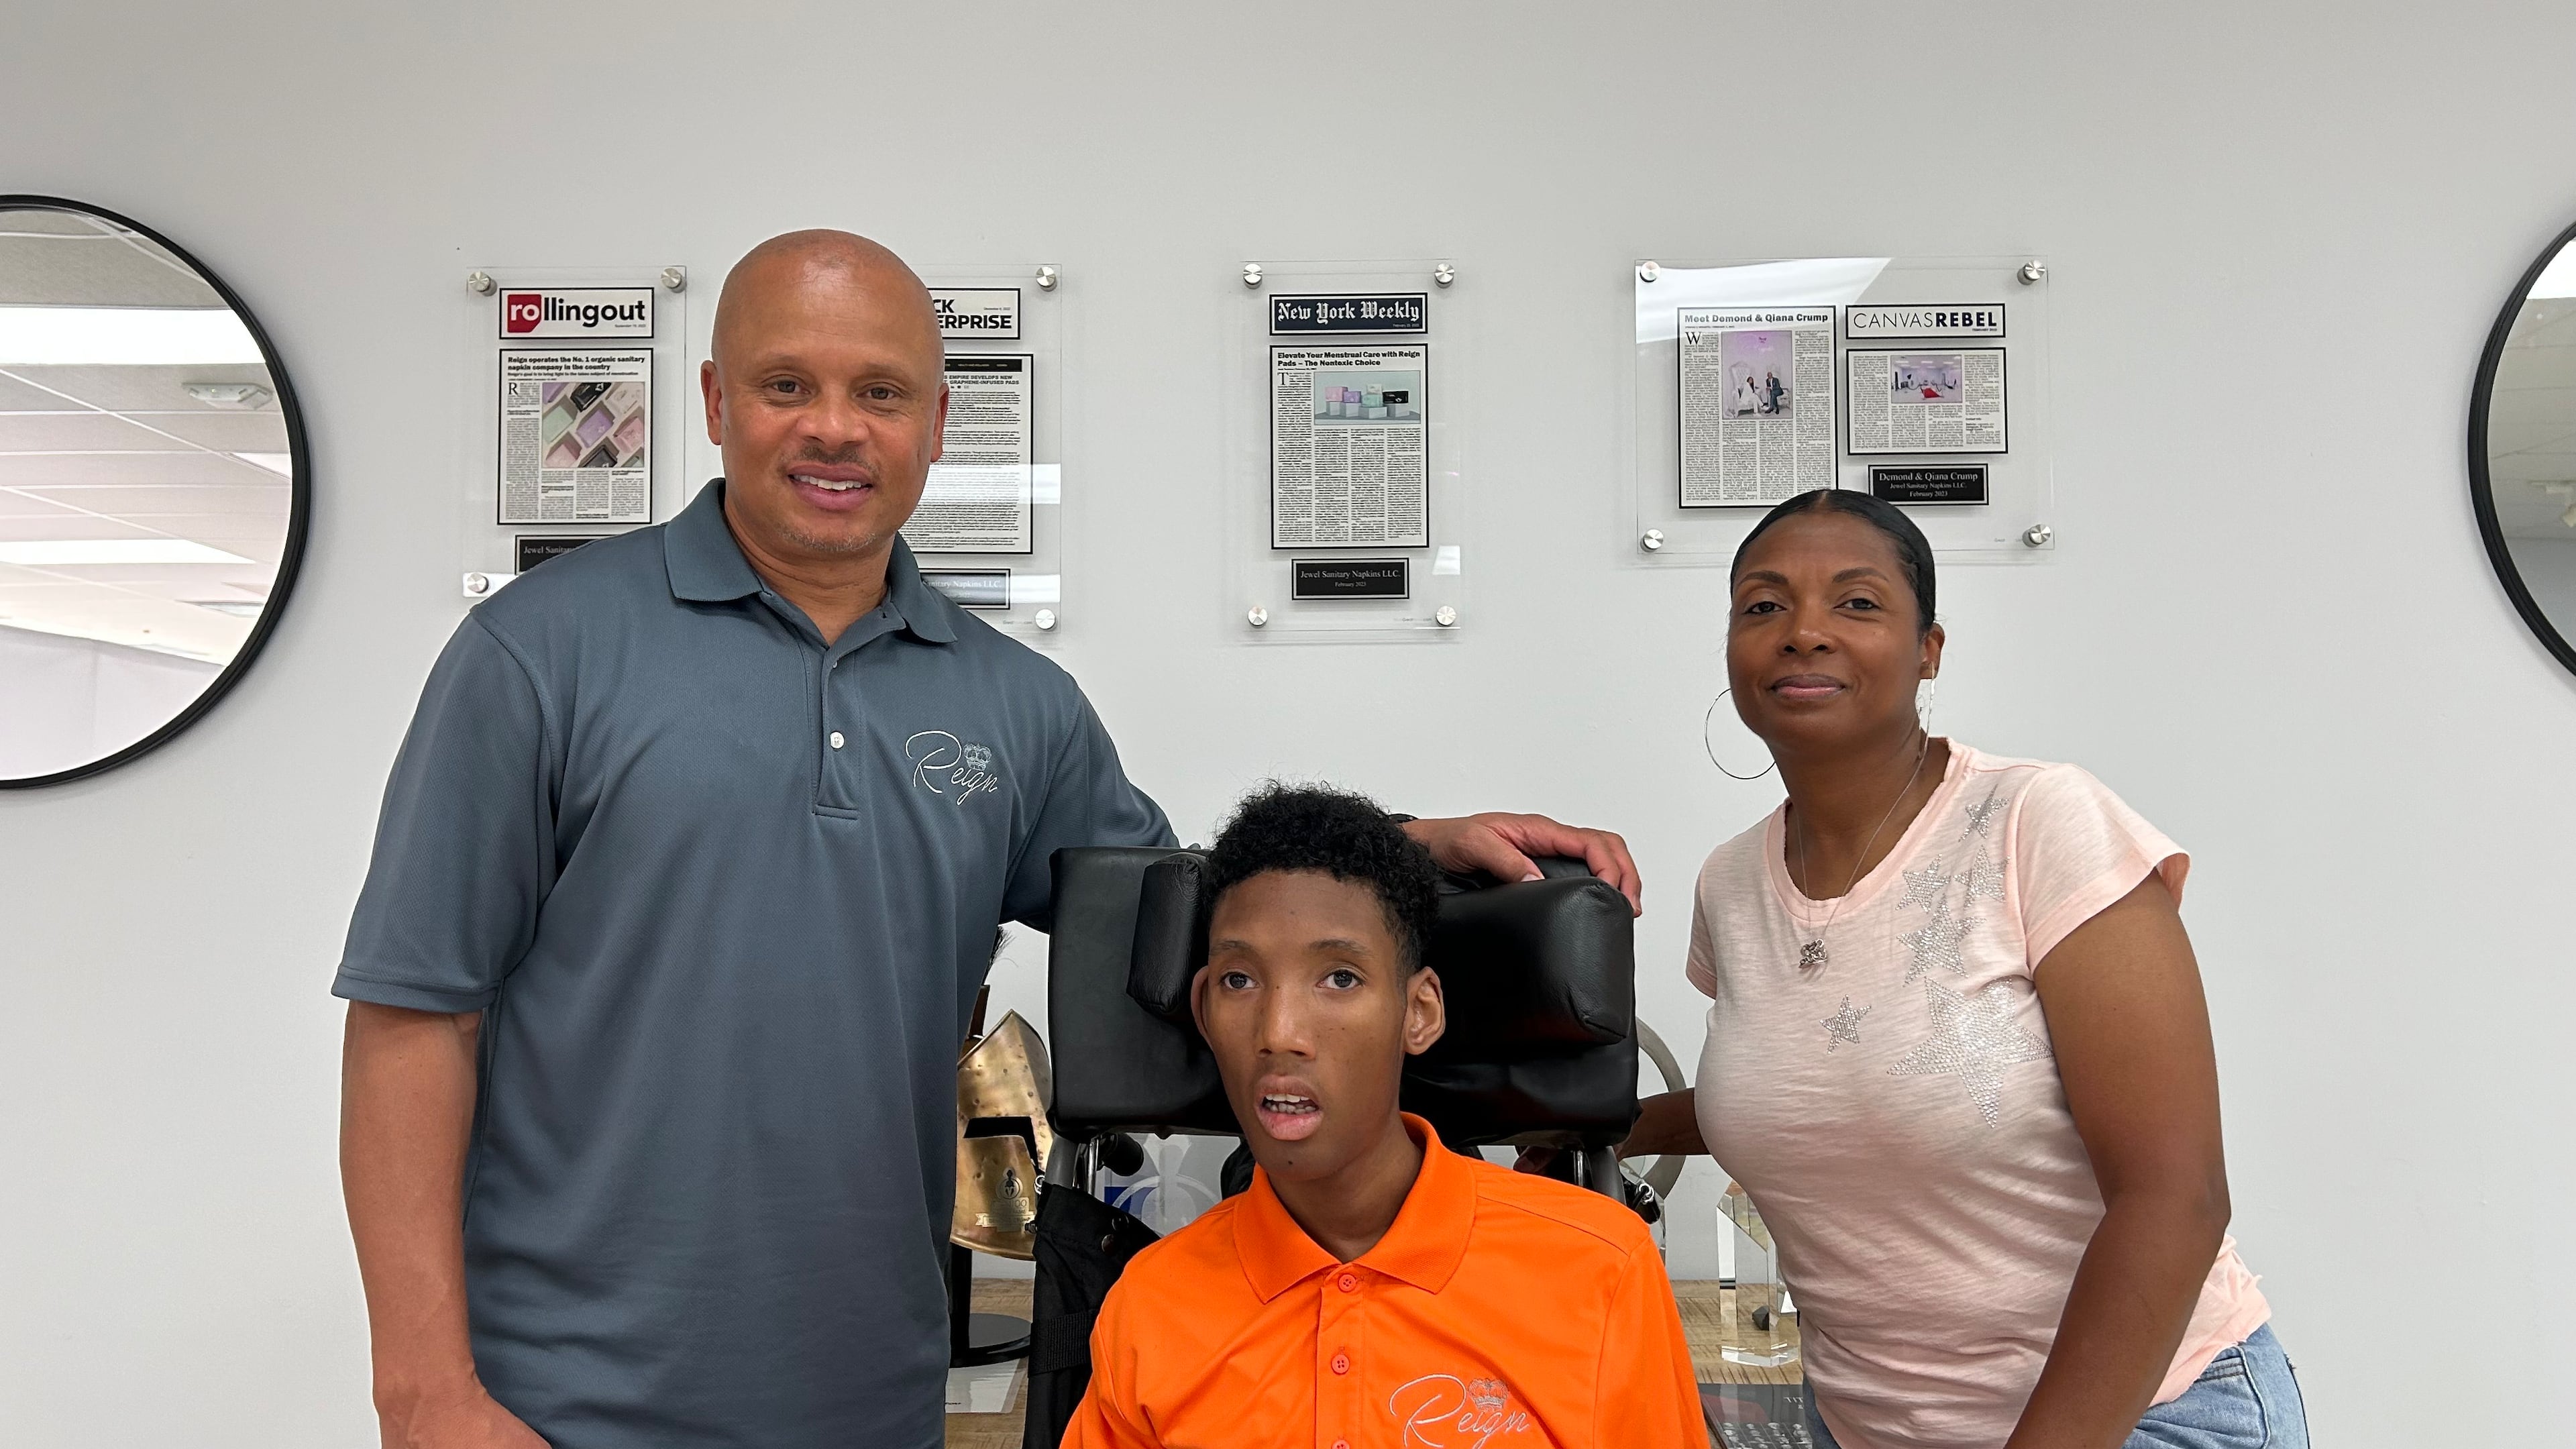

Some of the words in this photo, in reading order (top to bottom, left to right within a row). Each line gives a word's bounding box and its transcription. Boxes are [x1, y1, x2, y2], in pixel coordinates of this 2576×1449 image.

[510, 297, 645, 327] rollingout
[1278, 302, 1311, 322] New
[1316, 302, 1356, 325] York
[1360, 301, 1420, 322] Weekly
[1684, 315, 1709, 323] Meet
[1712, 314, 1752, 323] Demond
[1755, 314, 1763, 322] &
[1765, 313, 1794, 322] Qiana
[1796, 313, 1828, 323] Crump
[1854, 311, 1997, 328] CANVASREBEL
[937, 315, 1012, 329] ERPRISE
[1879, 472, 1912, 481] Demond
[1915, 472, 1923, 481] &
[1925, 472, 1949, 481] Qiana
[1950, 472, 1978, 482] Crump
[1322, 570, 1350, 579] Sanitary
[1352, 570, 1381, 579] Napkins
[953, 580, 981, 589] Napkins
[906, 730, 998, 806] Reign
[1389, 1373, 1529, 1449] Reign
